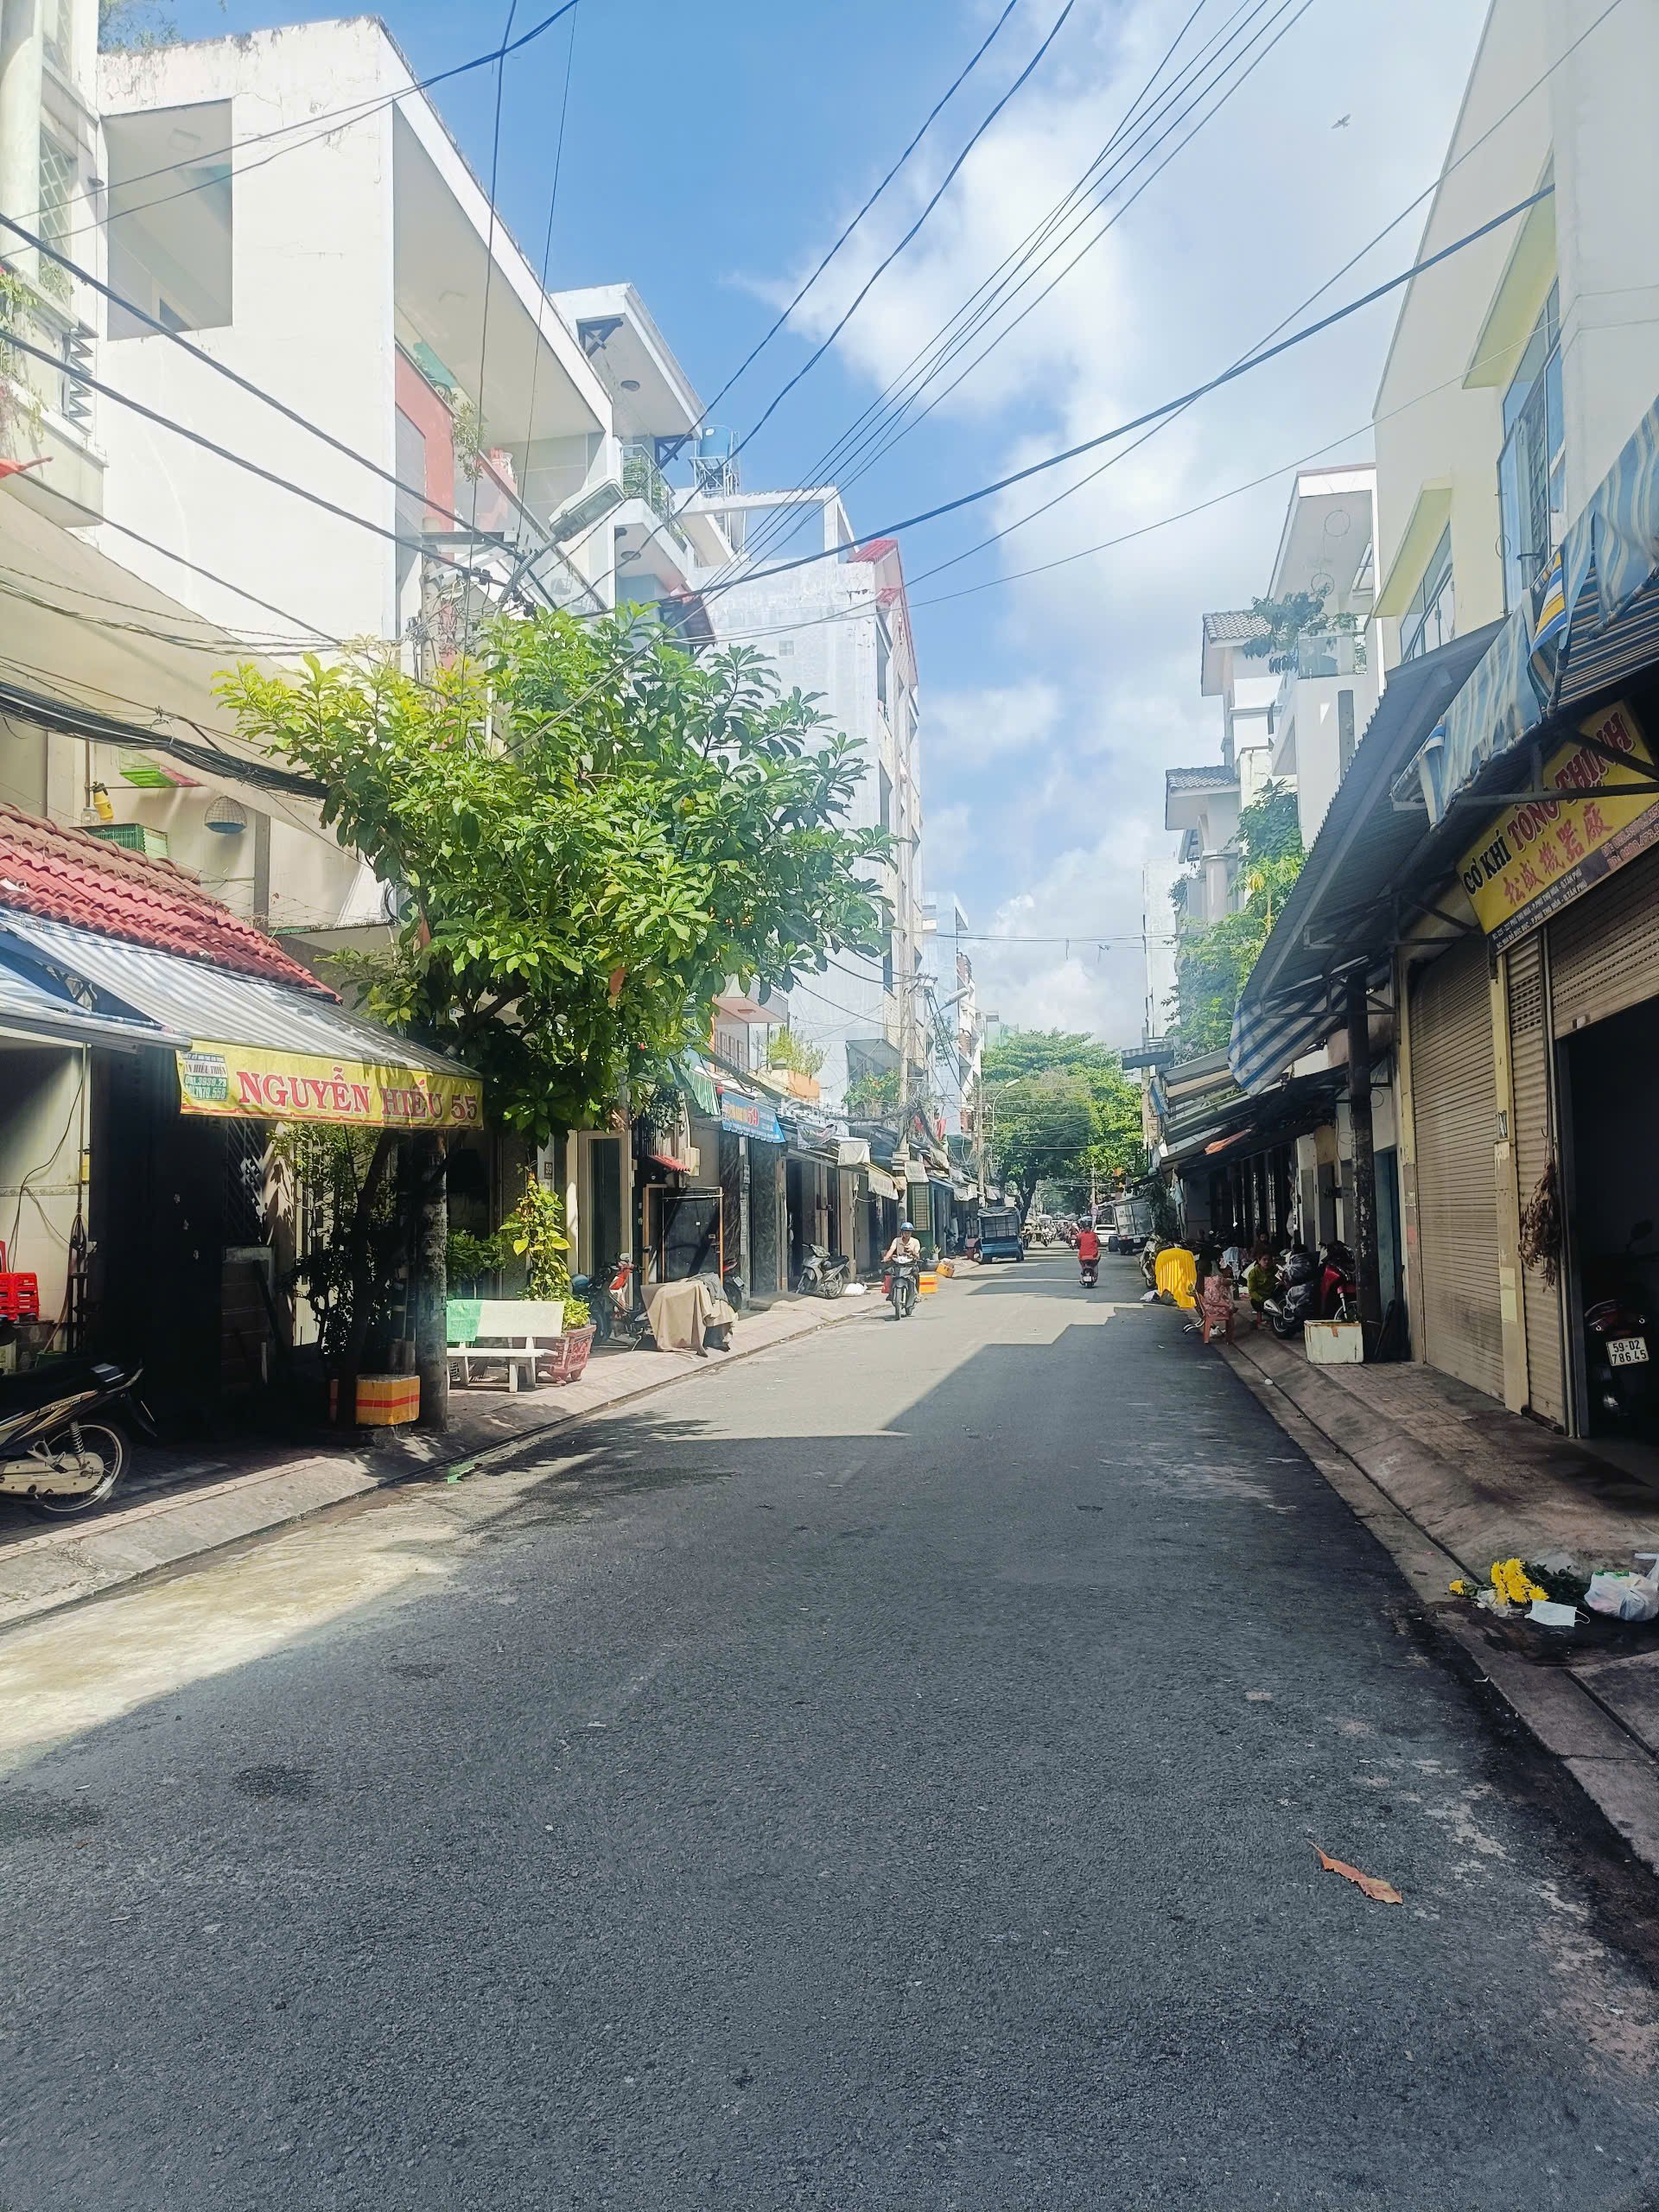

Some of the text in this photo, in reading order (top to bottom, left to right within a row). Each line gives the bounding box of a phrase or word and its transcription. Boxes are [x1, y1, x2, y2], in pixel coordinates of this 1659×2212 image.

[1463, 859, 1484, 896] CƠ
[1481, 829, 1512, 880] KHÍ
[236, 1066, 477, 1121] NGUYỄN HIẾU 55
[747, 1106, 759, 1127] 59
[1611, 1350, 1647, 1364] 786.45
[1612, 1340, 1641, 1353] 59-D2
